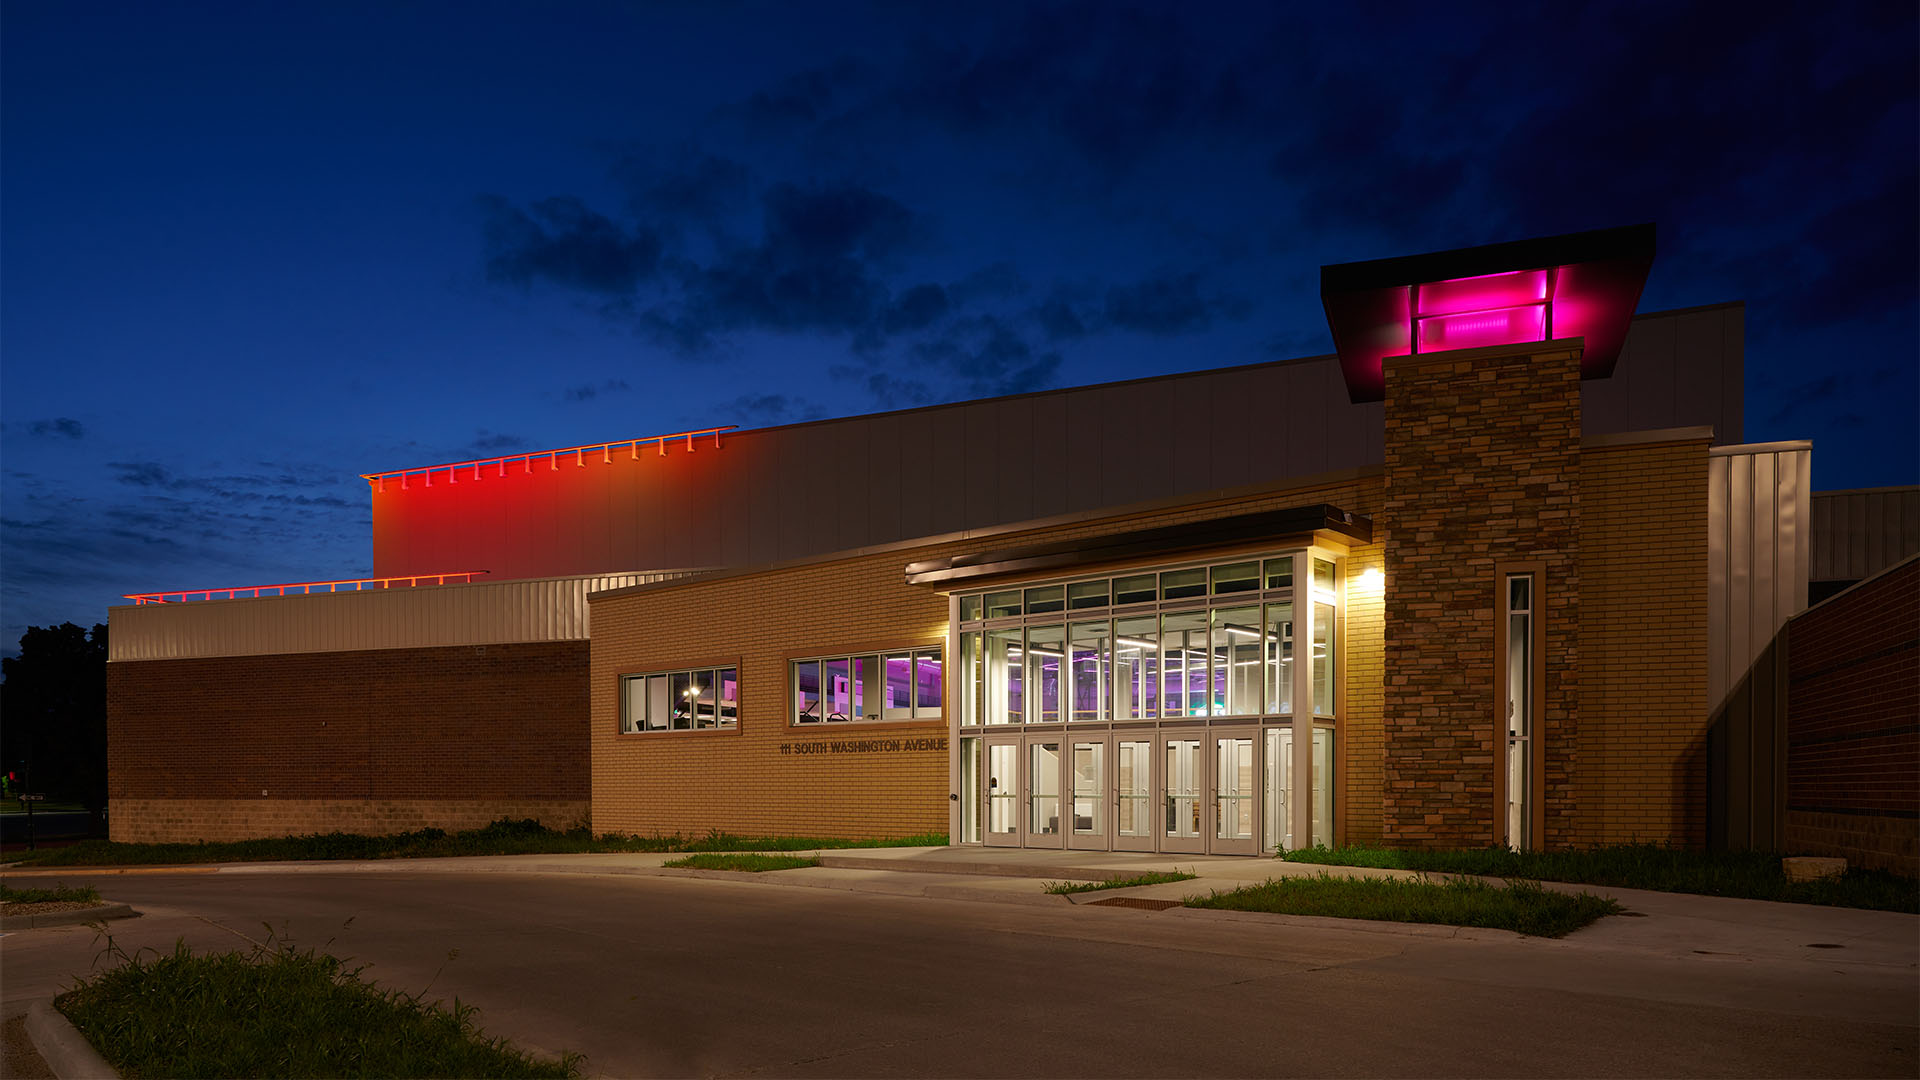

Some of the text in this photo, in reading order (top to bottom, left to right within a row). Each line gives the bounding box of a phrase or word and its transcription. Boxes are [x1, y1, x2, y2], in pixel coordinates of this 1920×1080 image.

[780, 738, 948, 755] 111 SOUTH WASHINGTON AVENUE
